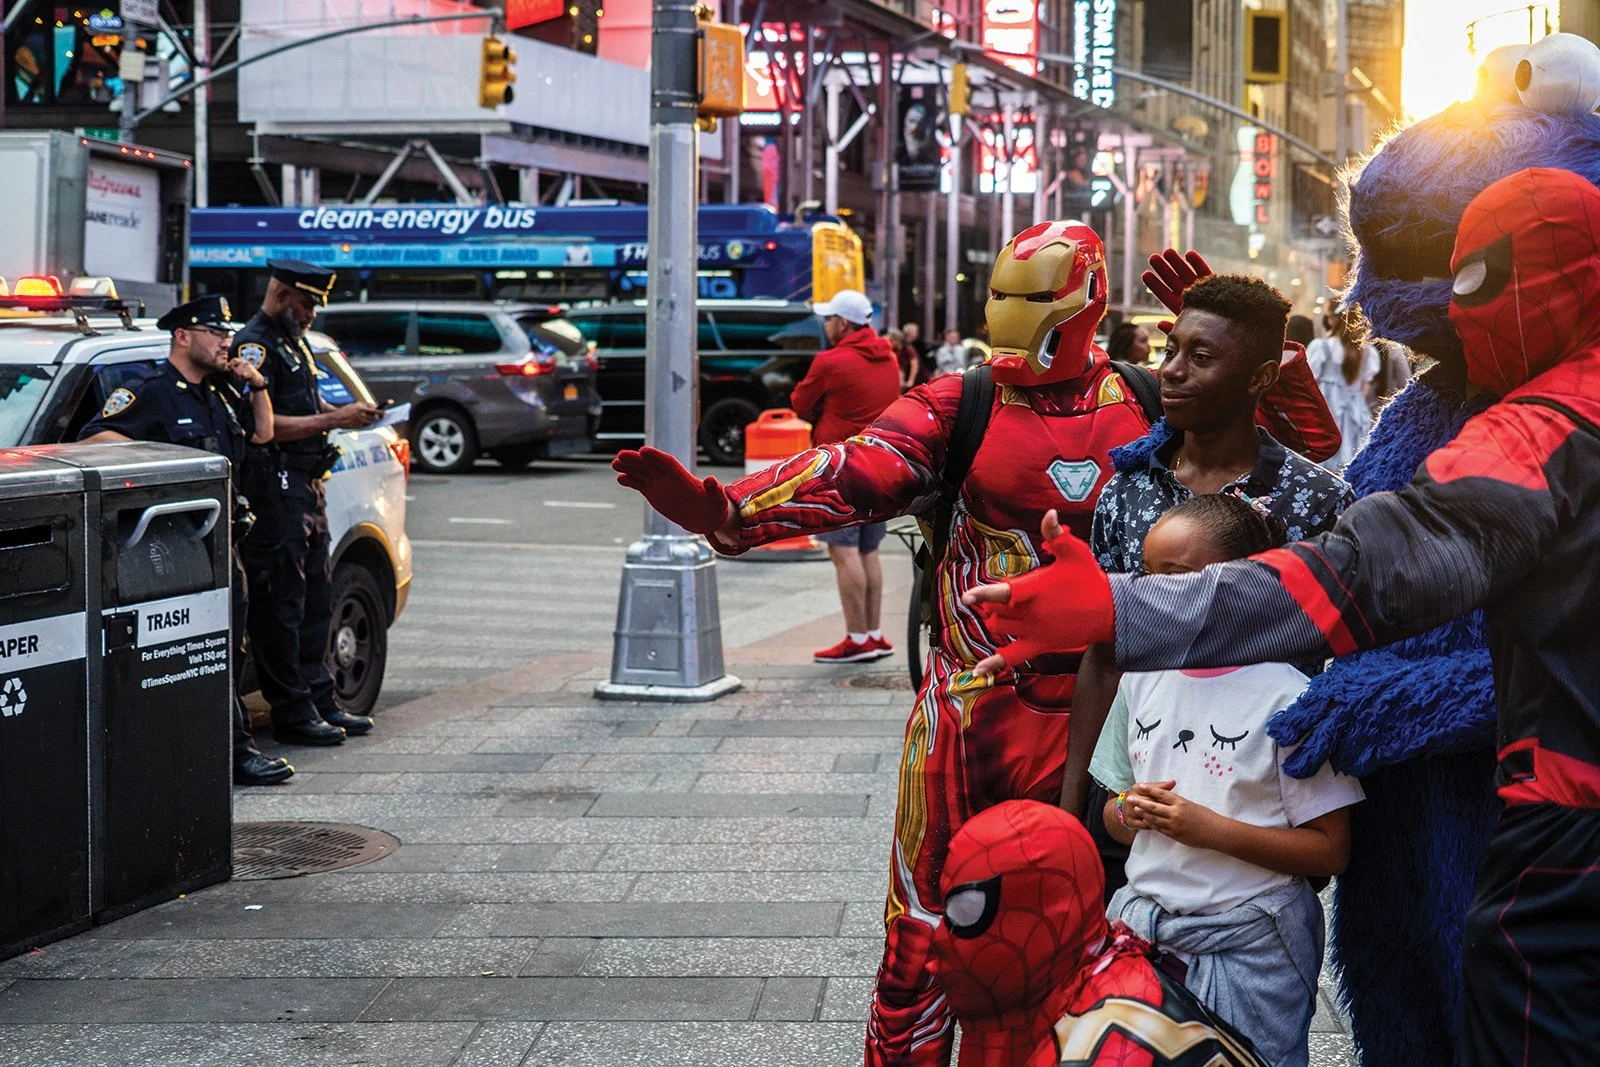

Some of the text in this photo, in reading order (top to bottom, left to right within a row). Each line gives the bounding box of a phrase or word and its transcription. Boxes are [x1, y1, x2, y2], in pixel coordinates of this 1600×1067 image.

[1255, 133, 1271, 224] BOWL
[298, 206, 536, 234] clean-energy bus
[147, 608, 190, 631] TRASH
[141, 637, 226, 661] For Everything Times Square
[188, 650, 227, 664] Visit TSQ.org
[141, 663, 227, 689] @TimesSquareNYC @TsqArts
